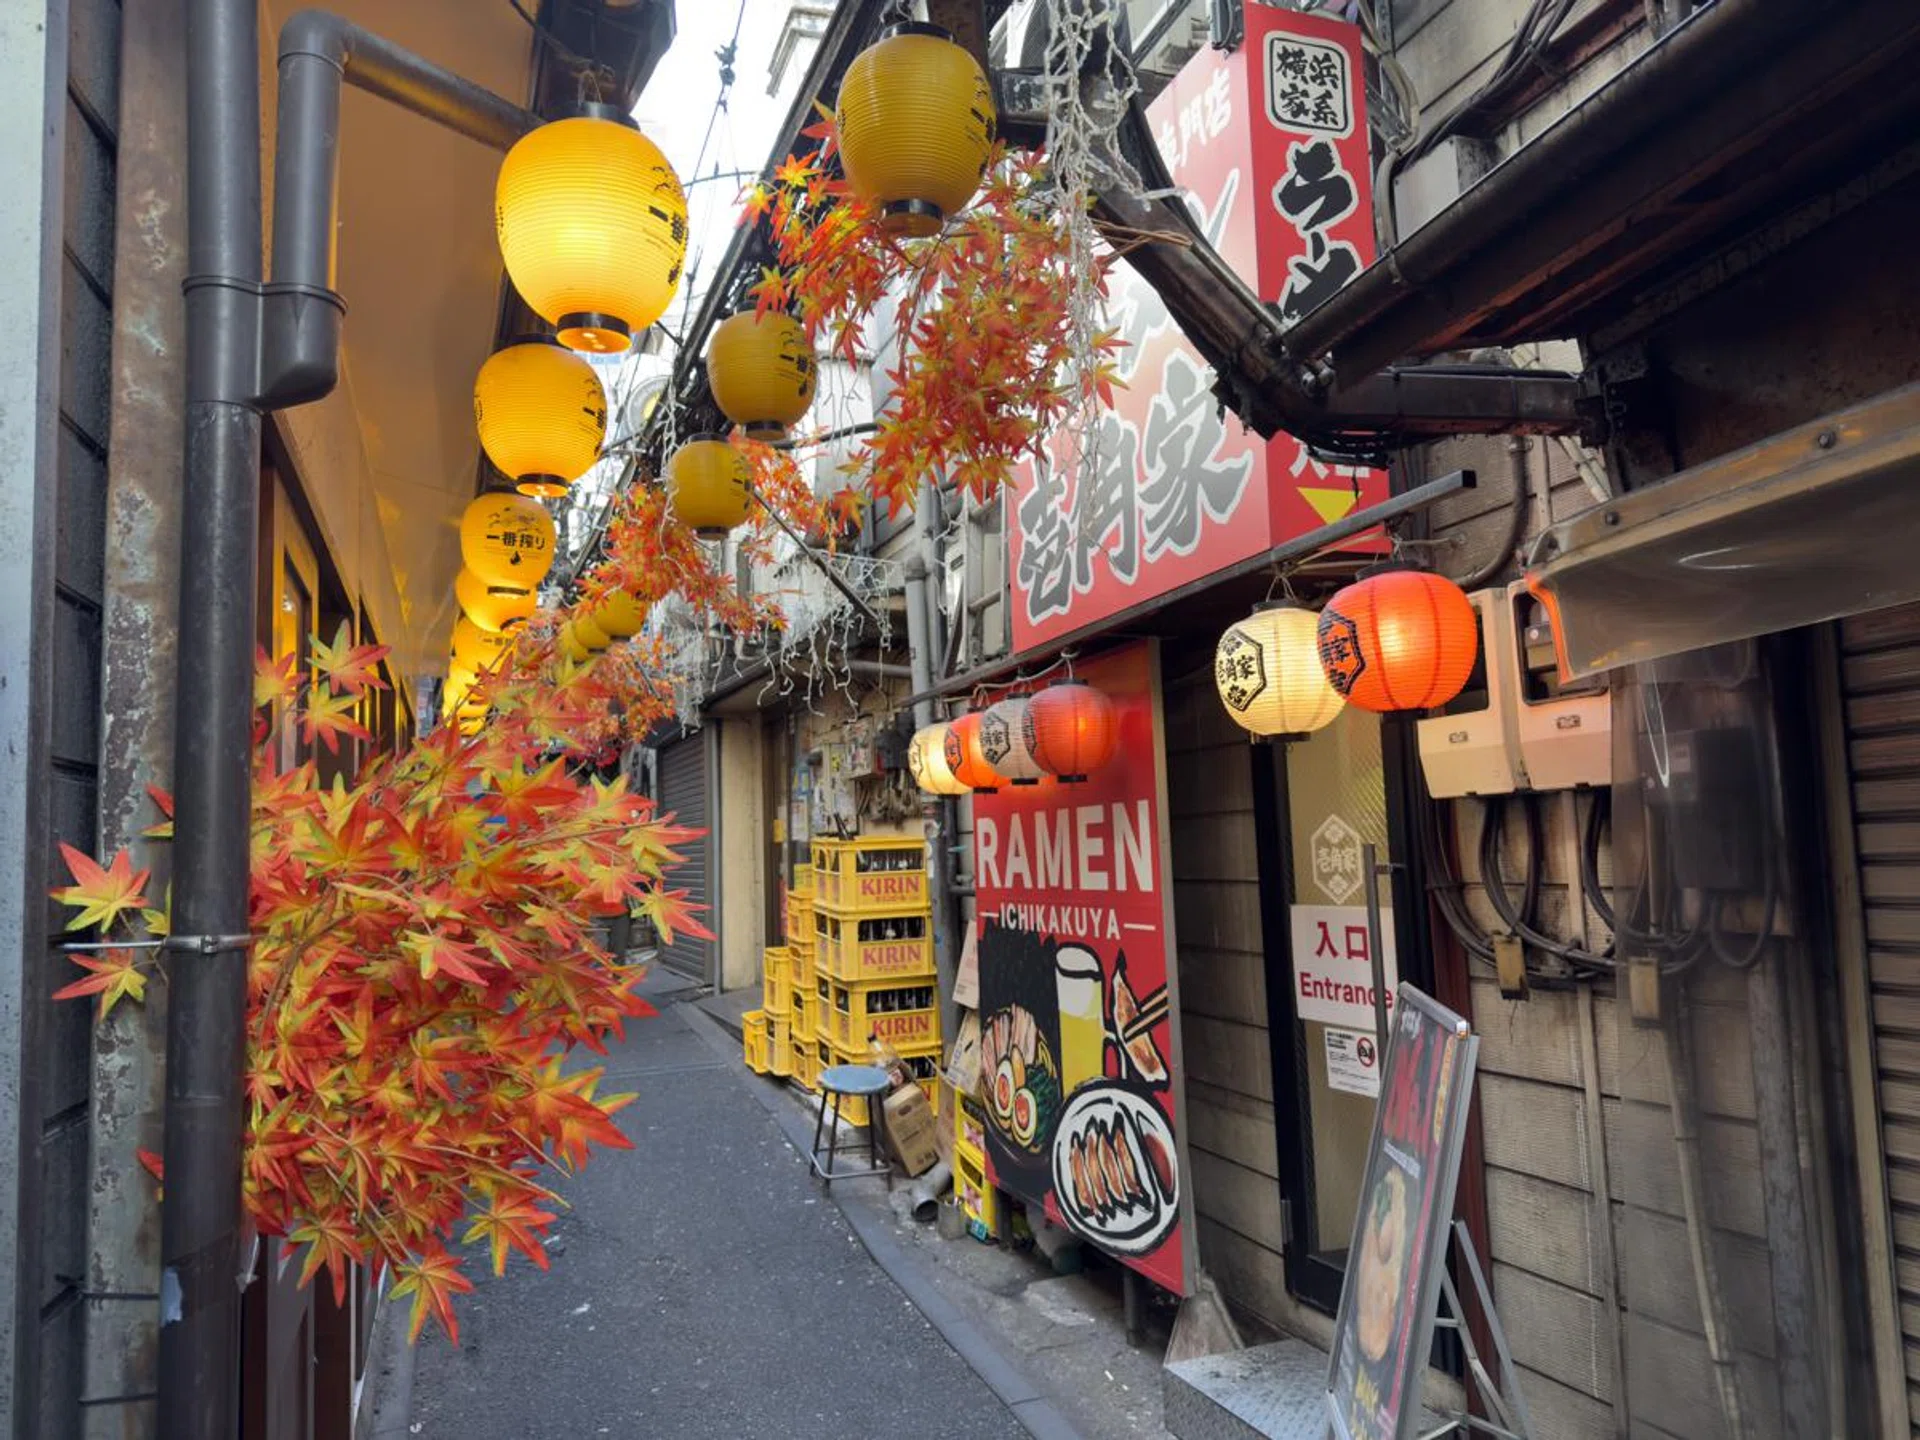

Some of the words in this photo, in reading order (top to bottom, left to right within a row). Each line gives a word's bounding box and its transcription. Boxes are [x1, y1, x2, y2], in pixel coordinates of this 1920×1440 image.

[975, 799, 1154, 892] RAMEN
[861, 875, 920, 896] KIRIN
[1000, 902, 1122, 941] ICHIKAKUYA
[863, 943, 921, 965] KIRIN
[1315, 921, 1370, 961] 入口
[872, 1015, 929, 1036] KIRIN
